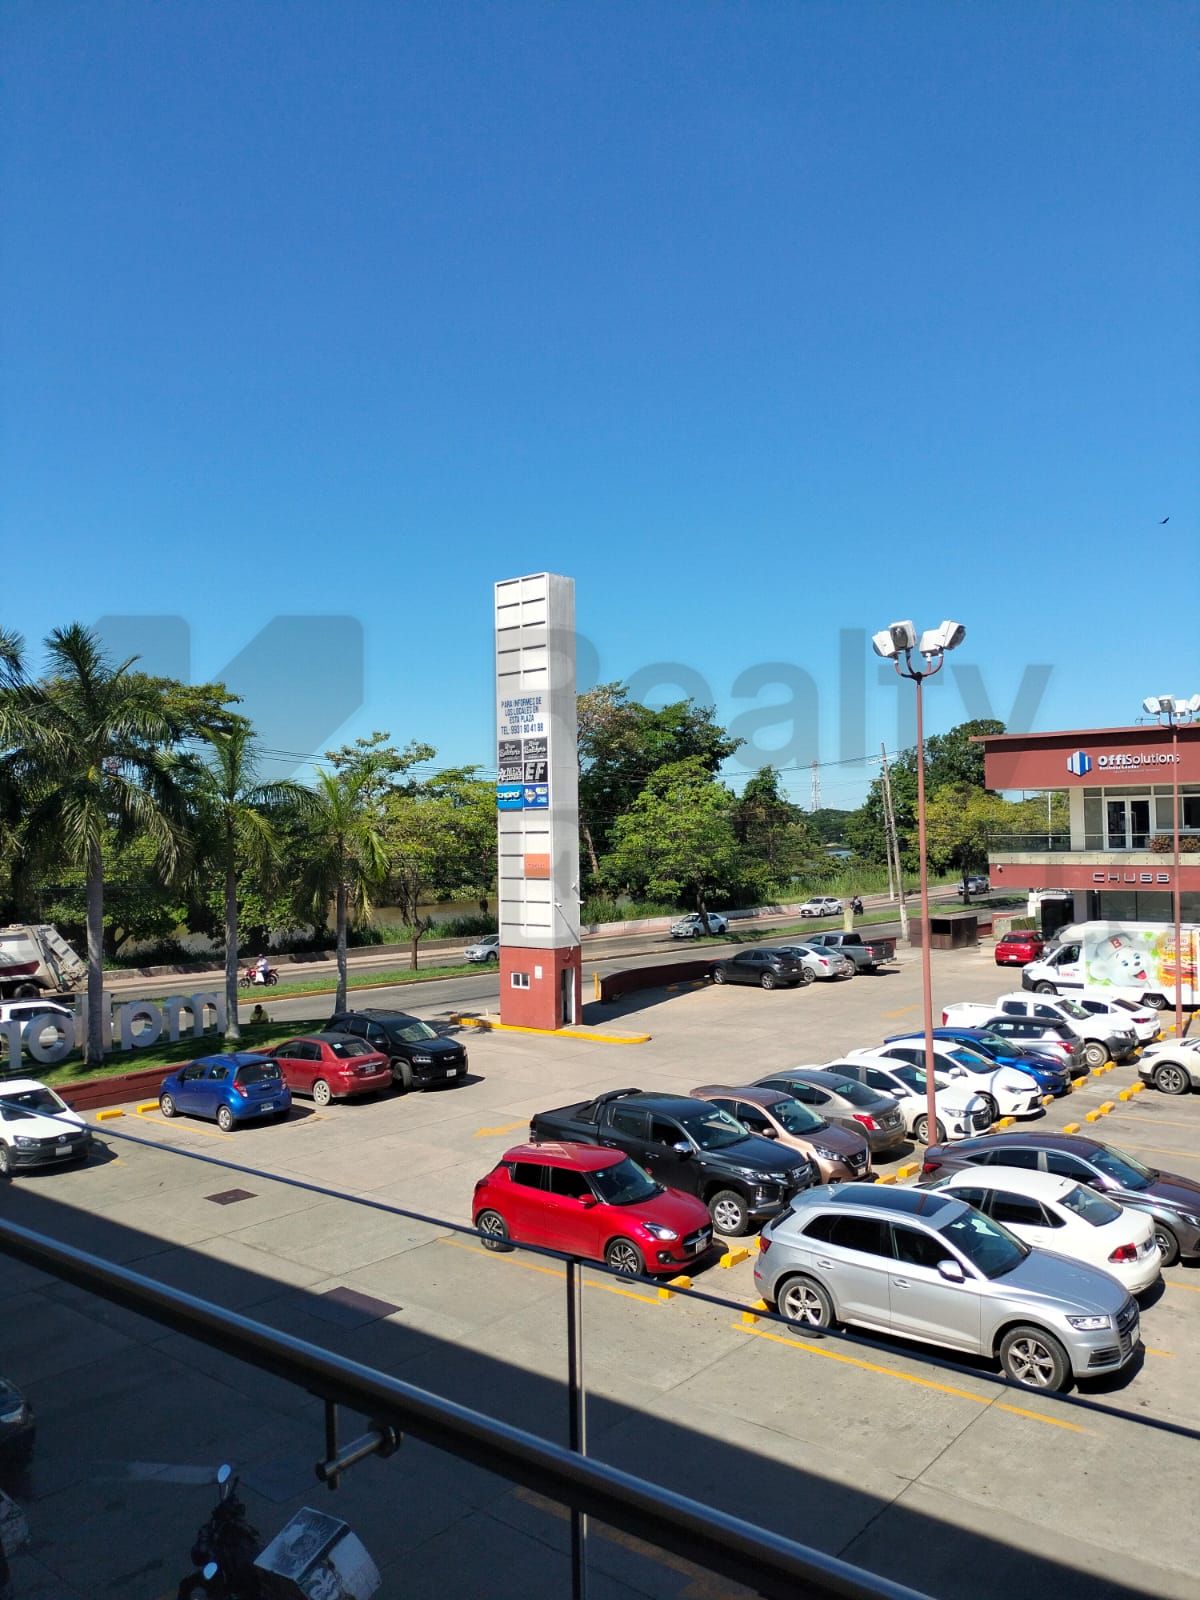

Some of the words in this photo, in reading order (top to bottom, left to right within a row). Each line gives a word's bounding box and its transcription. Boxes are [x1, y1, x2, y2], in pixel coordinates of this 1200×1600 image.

[520, 714, 534, 723] PLAZA
[525, 762, 545, 780] EF
[1093, 872, 1169, 883] CHUBB
